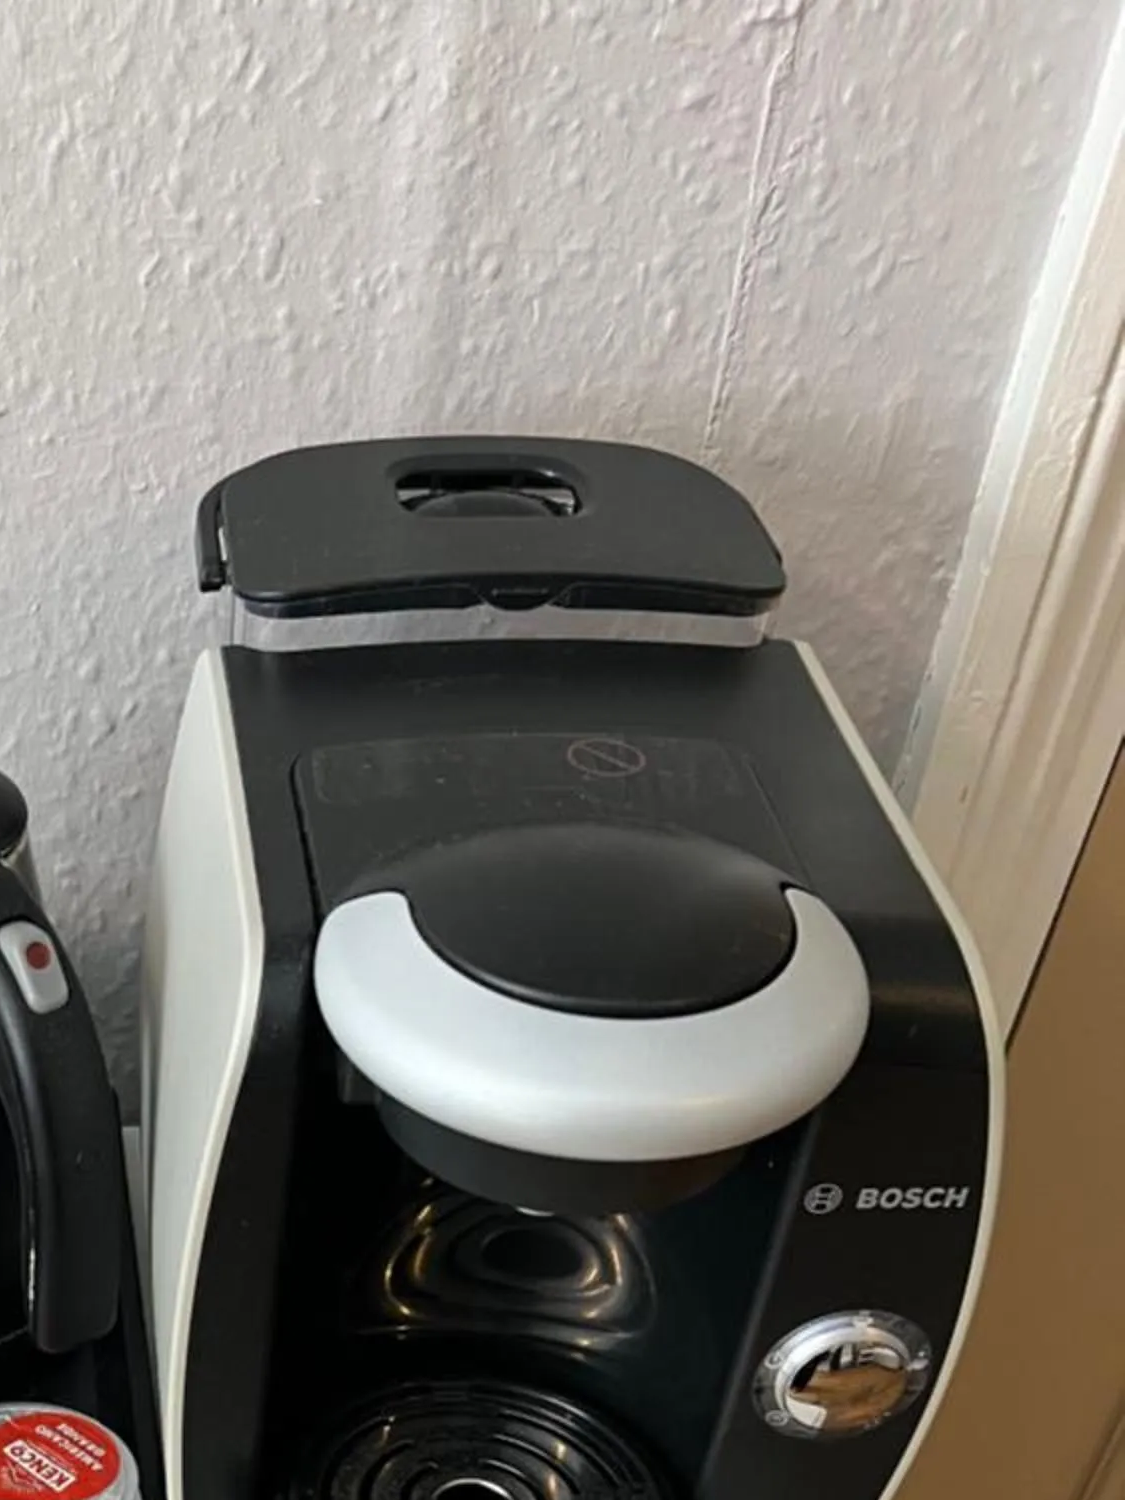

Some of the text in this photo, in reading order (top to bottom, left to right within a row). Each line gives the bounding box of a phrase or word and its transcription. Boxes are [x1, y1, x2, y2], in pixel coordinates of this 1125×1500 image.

[856, 1187, 970, 1209] BOSCH
[10, 1446, 70, 1488] KENCO
[35, 1424, 103, 1471] AMERICANO
